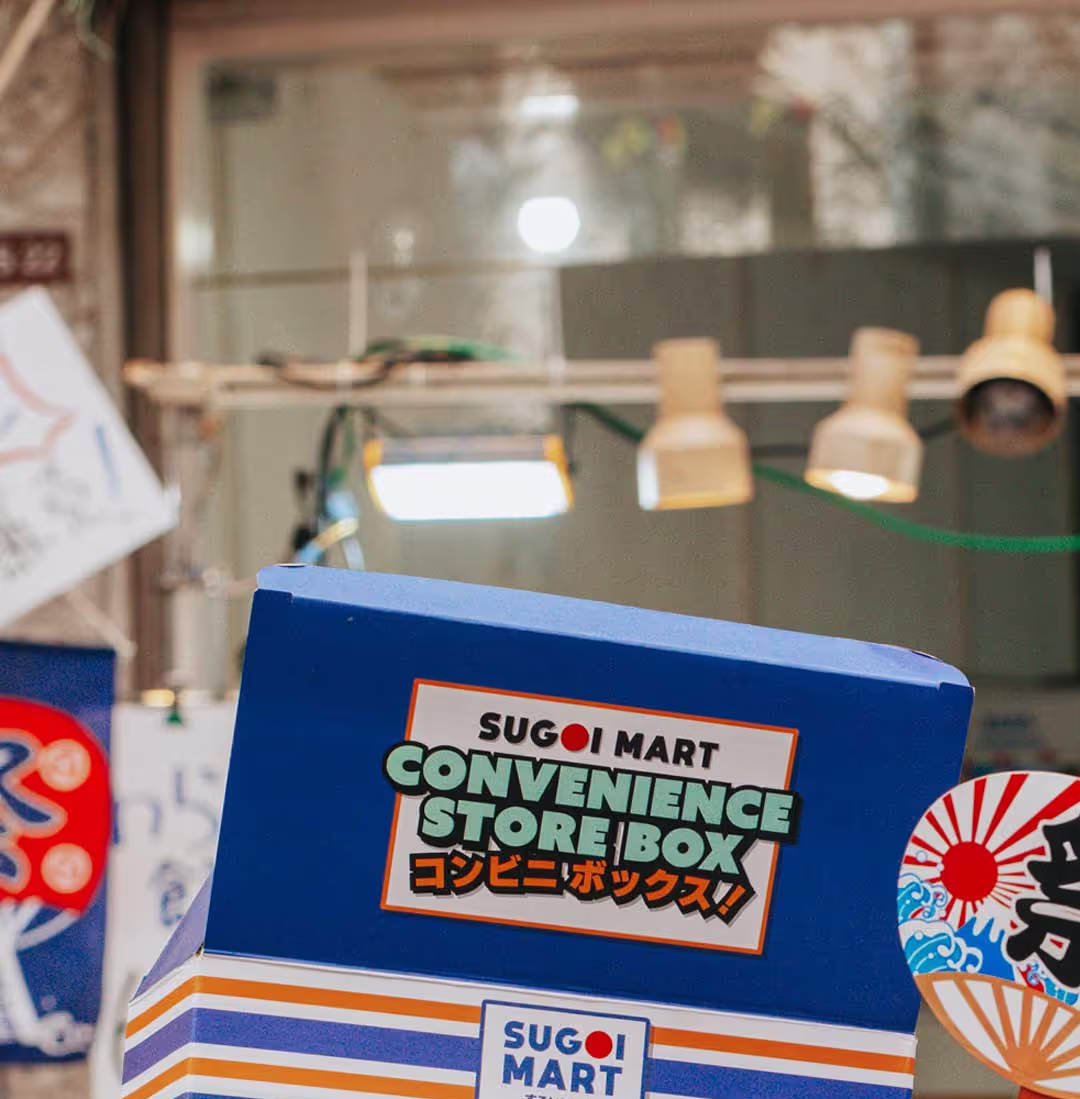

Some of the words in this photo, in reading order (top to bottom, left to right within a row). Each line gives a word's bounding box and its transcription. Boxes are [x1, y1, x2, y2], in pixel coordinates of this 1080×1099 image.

[614, 729, 720, 769] MART
[385, 743, 797, 836] CONVENIENCE
[420, 795, 612, 858] STORE
[623, 820, 745, 876] BOX
[413, 852, 560, 892] コンビニ
[502, 1053, 623, 1097] MART
